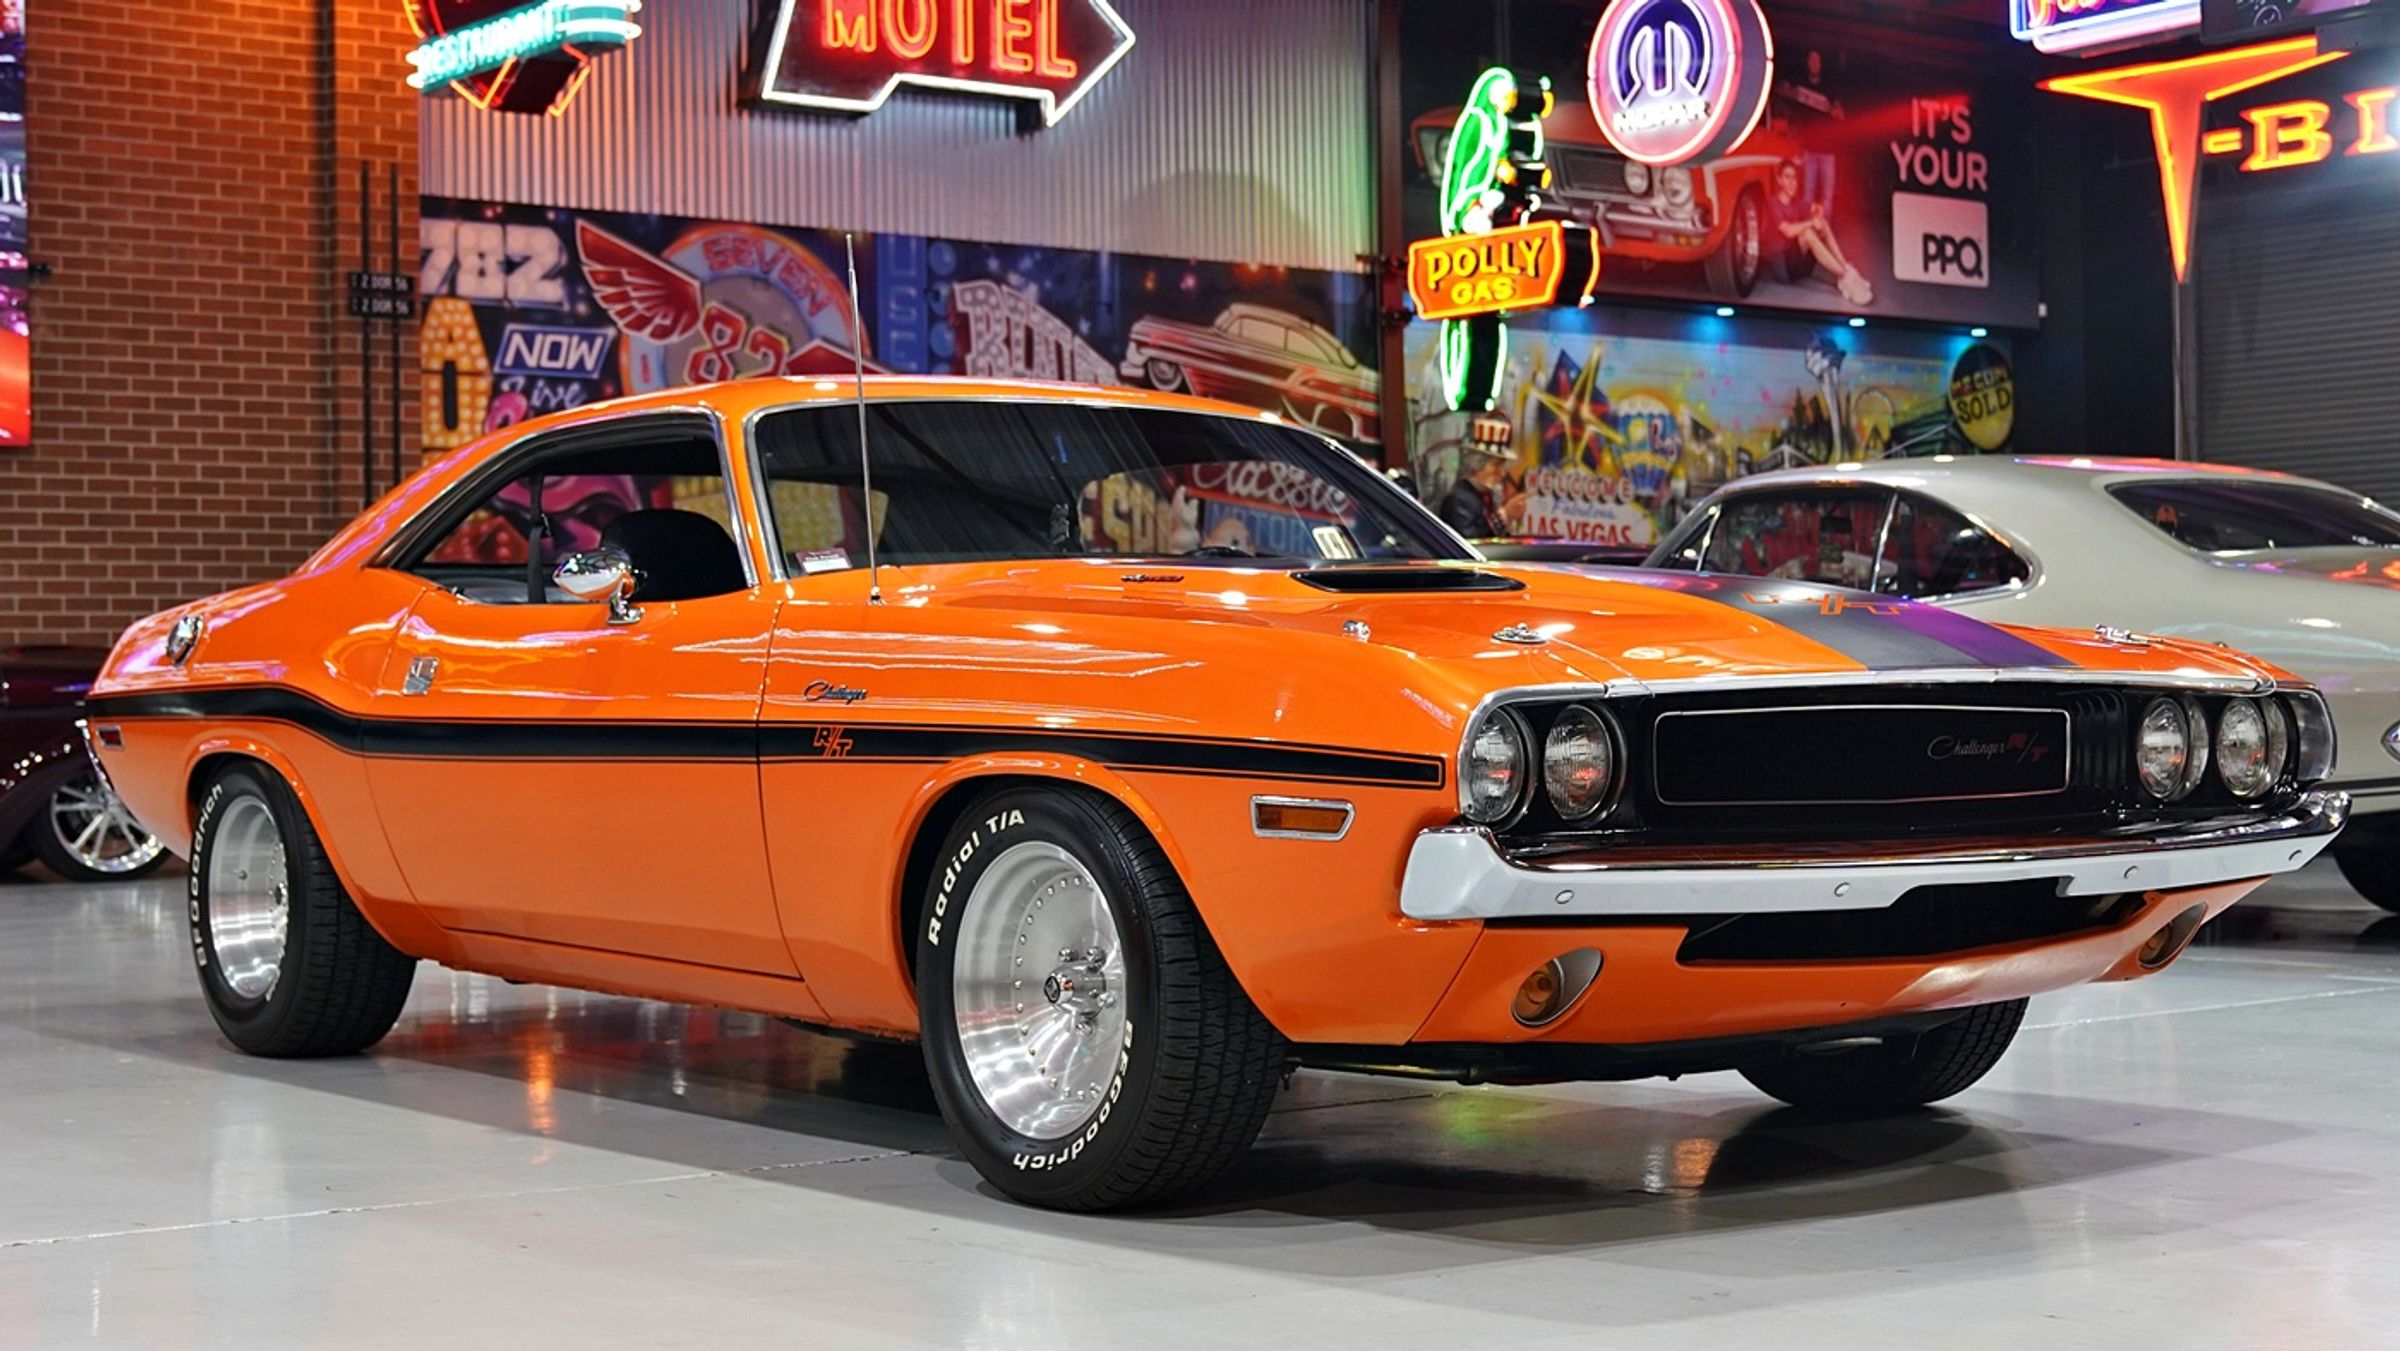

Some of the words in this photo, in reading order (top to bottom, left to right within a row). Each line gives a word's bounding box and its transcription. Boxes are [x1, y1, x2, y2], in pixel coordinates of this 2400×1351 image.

[818, 0, 1078, 78] MOTEL
[1911, 96, 1972, 145] IT'S
[1890, 140, 1988, 193] YOUR
[701, 231, 832, 318] SEVEN
[1424, 237, 1546, 291] POLLY
[1922, 232, 1984, 280] PPQ
[1451, 275, 1514, 305] GAS
[503, 331, 605, 372] NOW
[1956, 387, 2011, 424] SOLD
[1527, 470, 1633, 498] WELCOME
[1526, 514, 1560, 536] LAS
[1566, 520, 1632, 544] VEGAS
[813, 726, 854, 758] R/T
[1927, 735, 2005, 760] Challenger
[927, 830, 982, 946] Radial
[985, 807, 1026, 834] T/A
